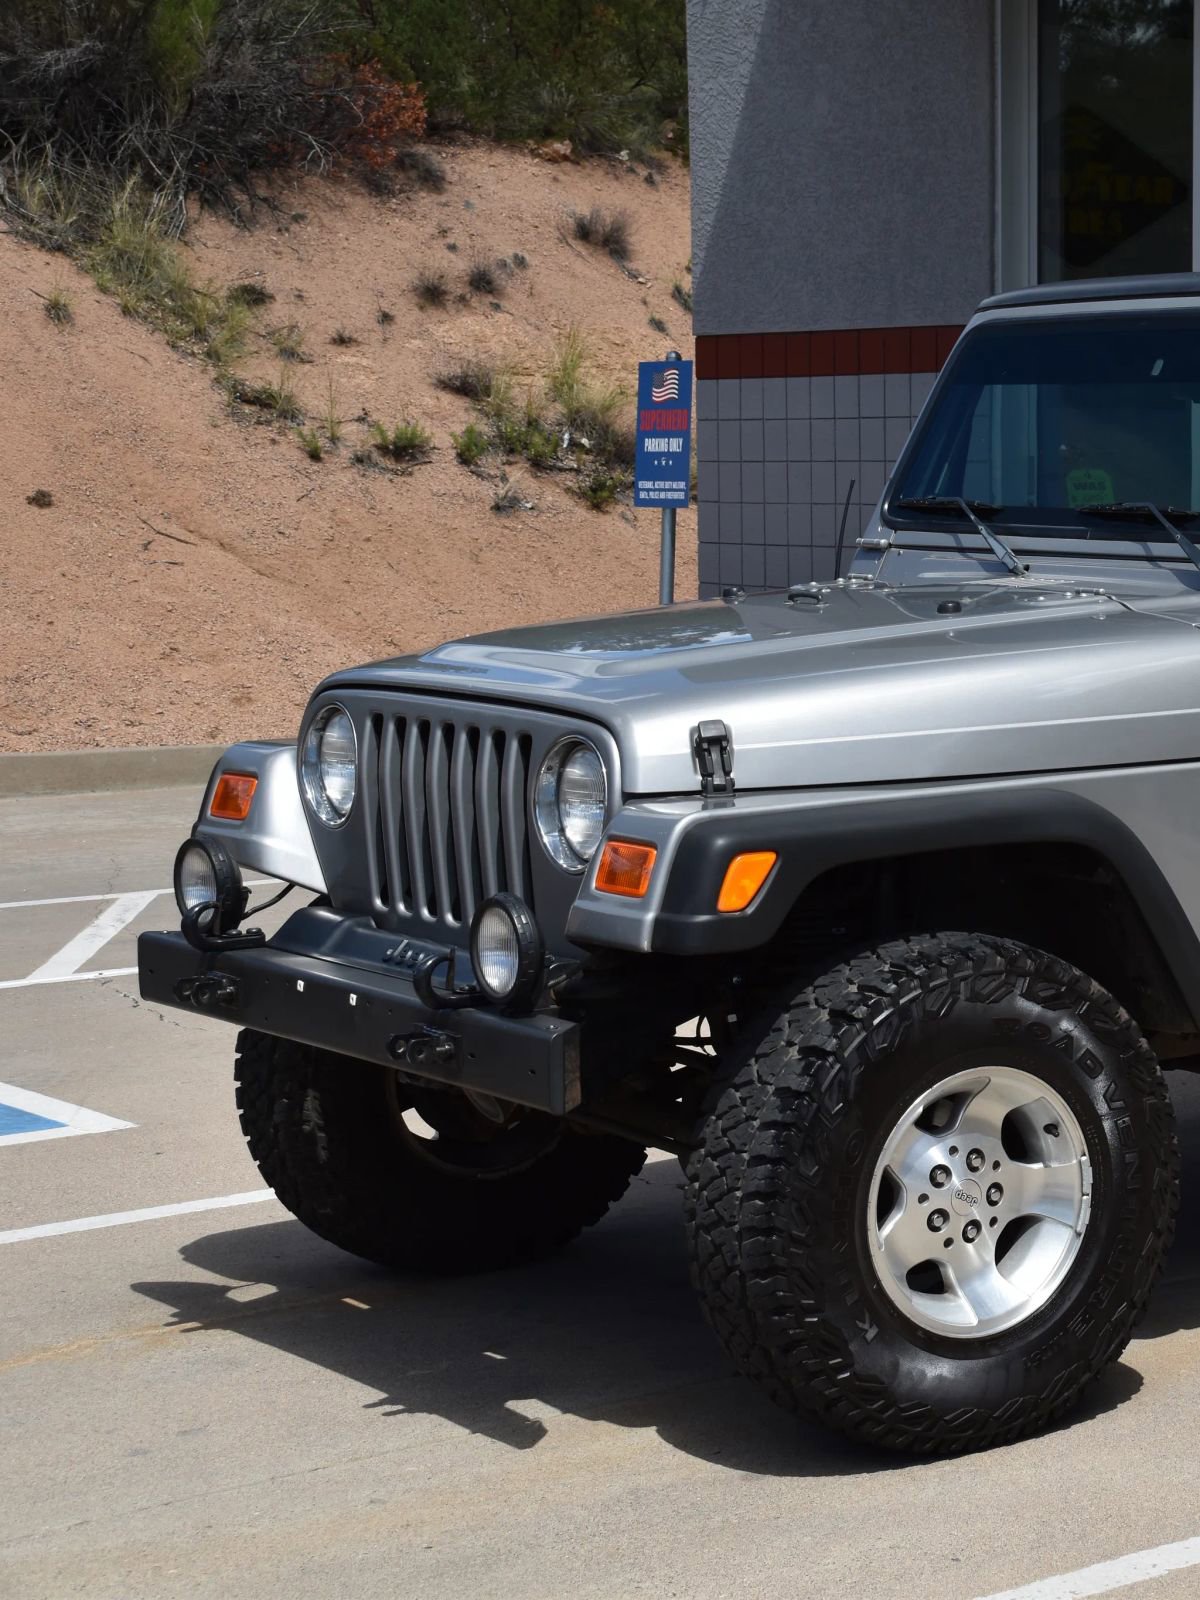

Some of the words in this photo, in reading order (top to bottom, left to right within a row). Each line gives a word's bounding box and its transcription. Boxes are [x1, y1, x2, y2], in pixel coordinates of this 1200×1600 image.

[644, 437, 668, 453] PARKING
[669, 437, 683, 453] ONLY
[954, 1189, 979, 1208] Jeep
